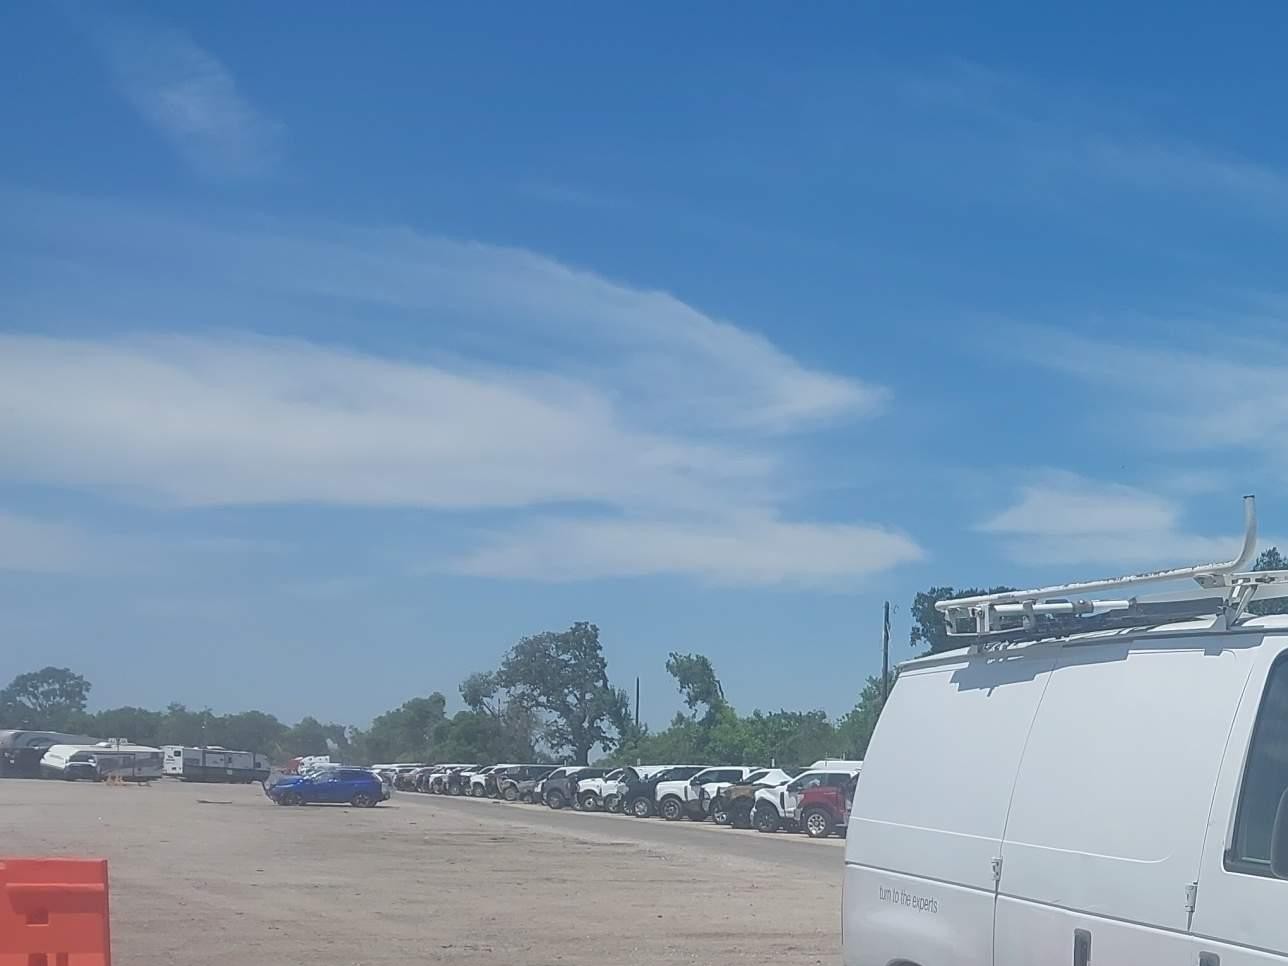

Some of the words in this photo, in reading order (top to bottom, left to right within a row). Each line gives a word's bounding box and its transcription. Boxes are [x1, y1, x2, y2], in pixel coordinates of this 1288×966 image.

[879, 885, 892, 900] turn
[892, 888, 900, 903] to
[900, 889, 912, 907] the
[912, 895, 938, 914] experts
